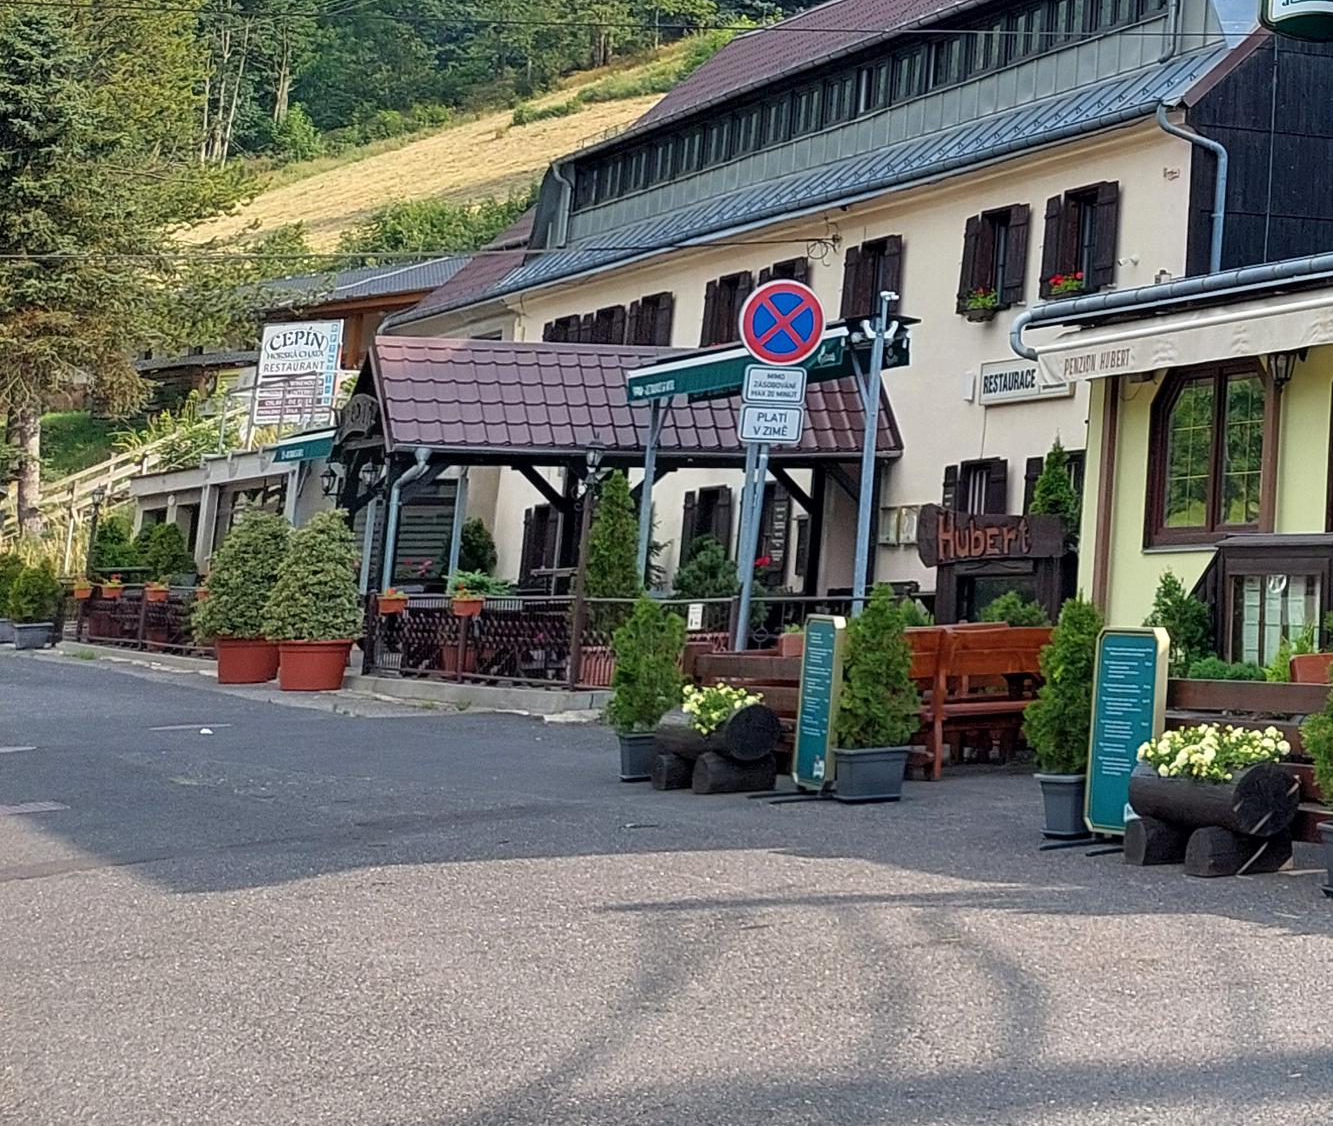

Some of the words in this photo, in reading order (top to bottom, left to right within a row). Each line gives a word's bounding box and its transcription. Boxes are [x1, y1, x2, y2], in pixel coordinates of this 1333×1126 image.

[269, 326, 325, 351] CEPÍN
[263, 361, 325, 373] RESTAURANT
[1064, 353, 1096, 377] PENZION
[1099, 348, 1131, 371] HUBERT
[983, 368, 1037, 394] RESTAURACE
[756, 411, 788, 423] PLATÍ
[753, 425, 761, 435] V
[762, 425, 788, 437] ZIMĚ
